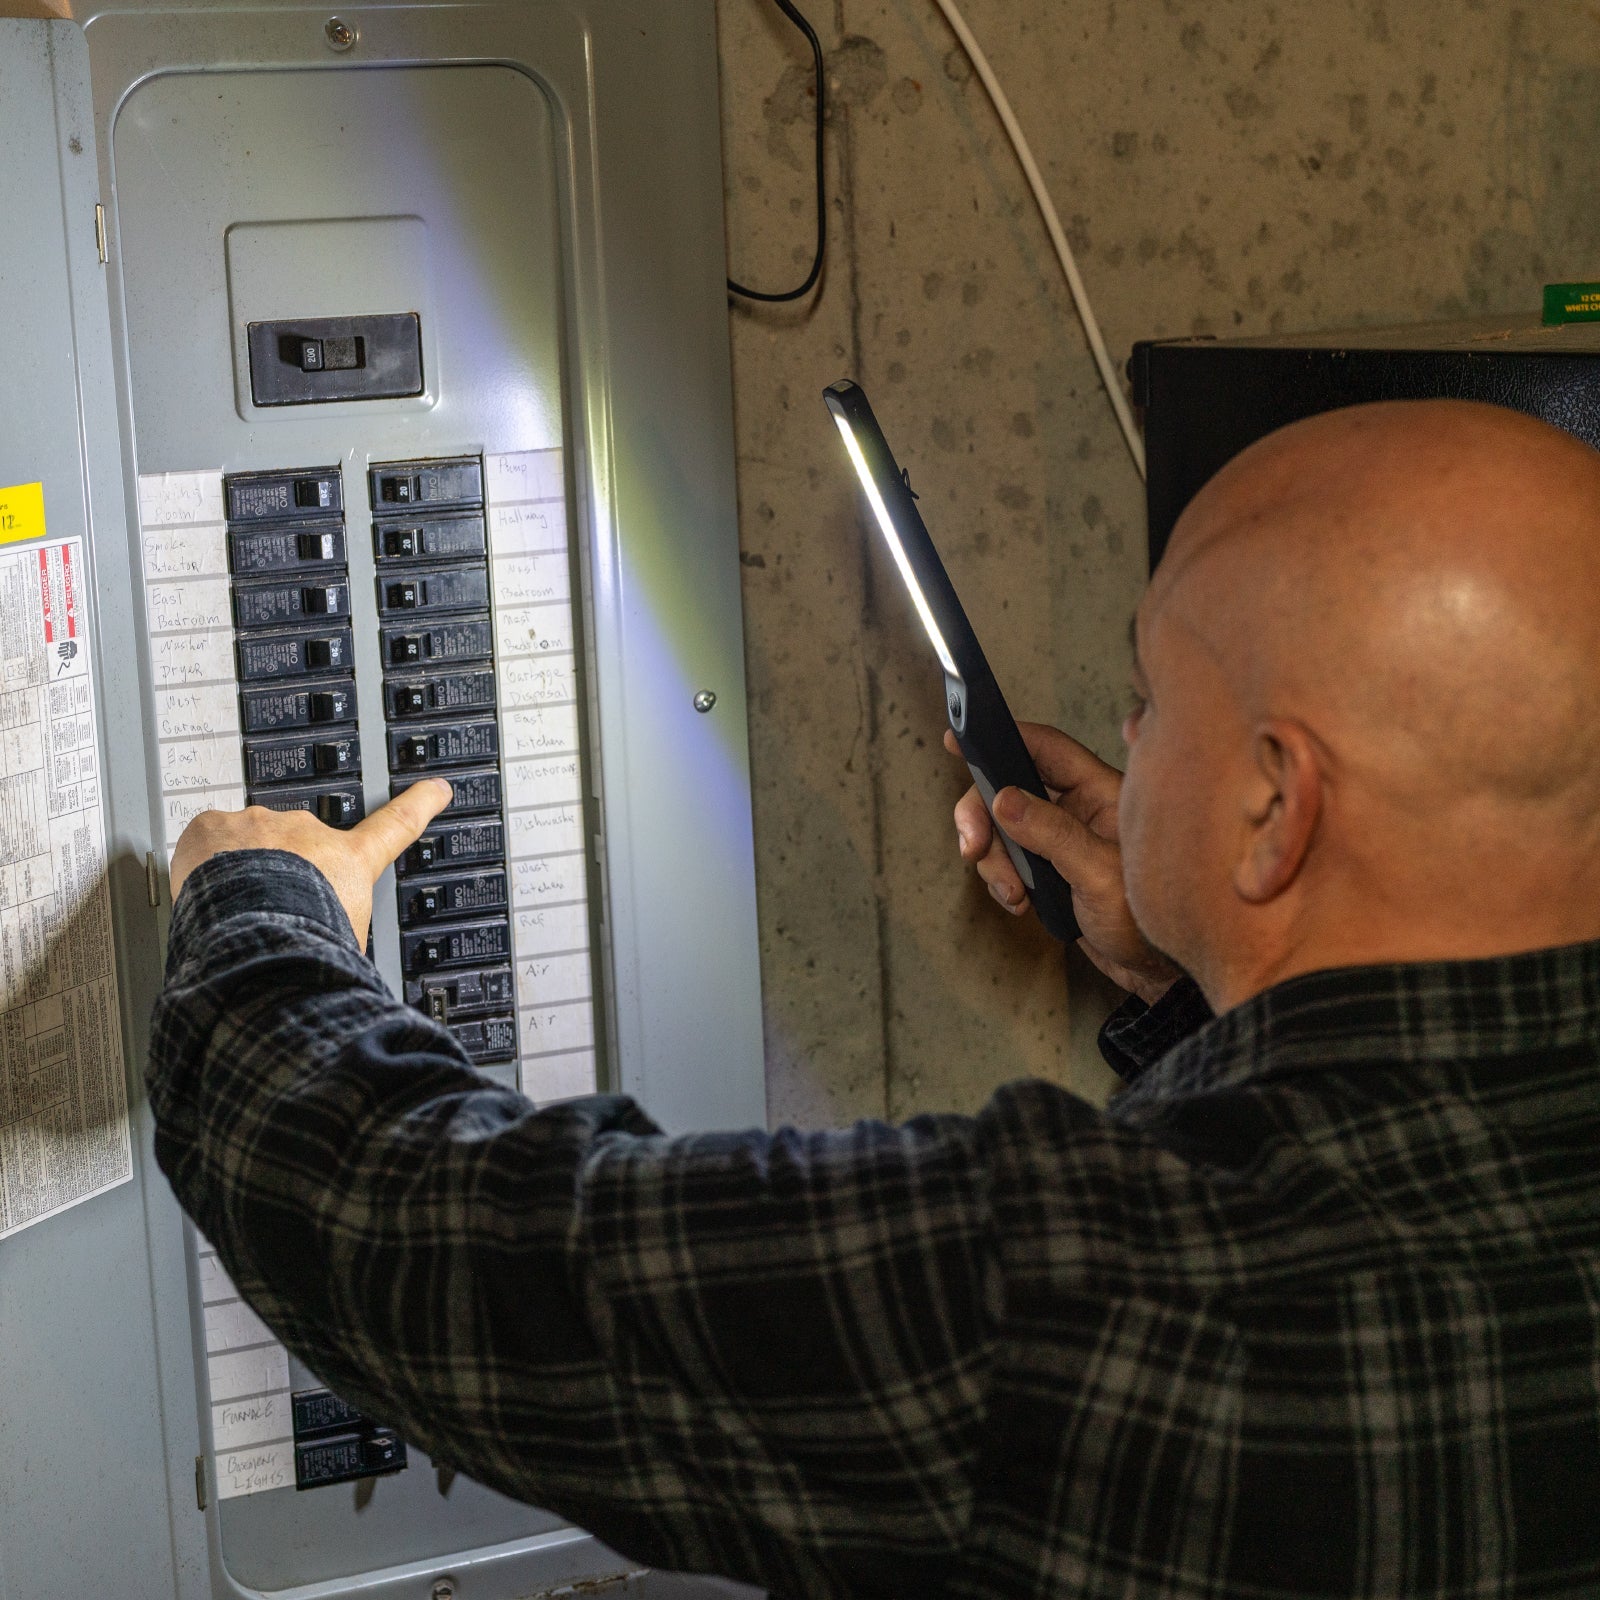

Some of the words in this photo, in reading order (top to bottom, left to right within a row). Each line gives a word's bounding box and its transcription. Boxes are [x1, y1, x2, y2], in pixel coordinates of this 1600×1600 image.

[307, 347, 316, 363] 200
[320, 488, 329, 499] 20
[400, 485, 408, 496] 20
[498, 507, 549, 529] Hallway
[144, 536, 187, 553] Smoke
[403, 538, 411, 549] 20
[41, 568, 50, 610] DANGER
[64, 563, 73, 605] PELIGRO
[500, 583, 554, 600] Bedroom
[329, 595, 337, 606] 20
[405, 590, 413, 601] 20
[158, 611, 220, 630] Bedroom
[331, 645, 339, 657] 20
[408, 643, 417, 655] 20
[503, 637, 564, 653] Bedroom
[506, 662, 565, 686] Garbage
[412, 694, 422, 705] 20
[509, 683, 569, 706] Disposal
[335, 701, 343, 713] 20
[513, 710, 543, 726] East
[162, 720, 214, 741] Garage
[167, 747, 198, 765] East
[339, 750, 347, 762] 20
[416, 745, 425, 756] 20
[164, 772, 212, 794] Garage
[343, 801, 350, 812] 20
[422, 849, 432, 860] 20
[426, 898, 435, 908] 20
[519, 912, 545, 929] Ref
[429, 948, 438, 959] 20
[525, 963, 551, 977] Air
[528, 1013, 557, 1031] Air
[233, 1470, 284, 1490] LIGHTS
